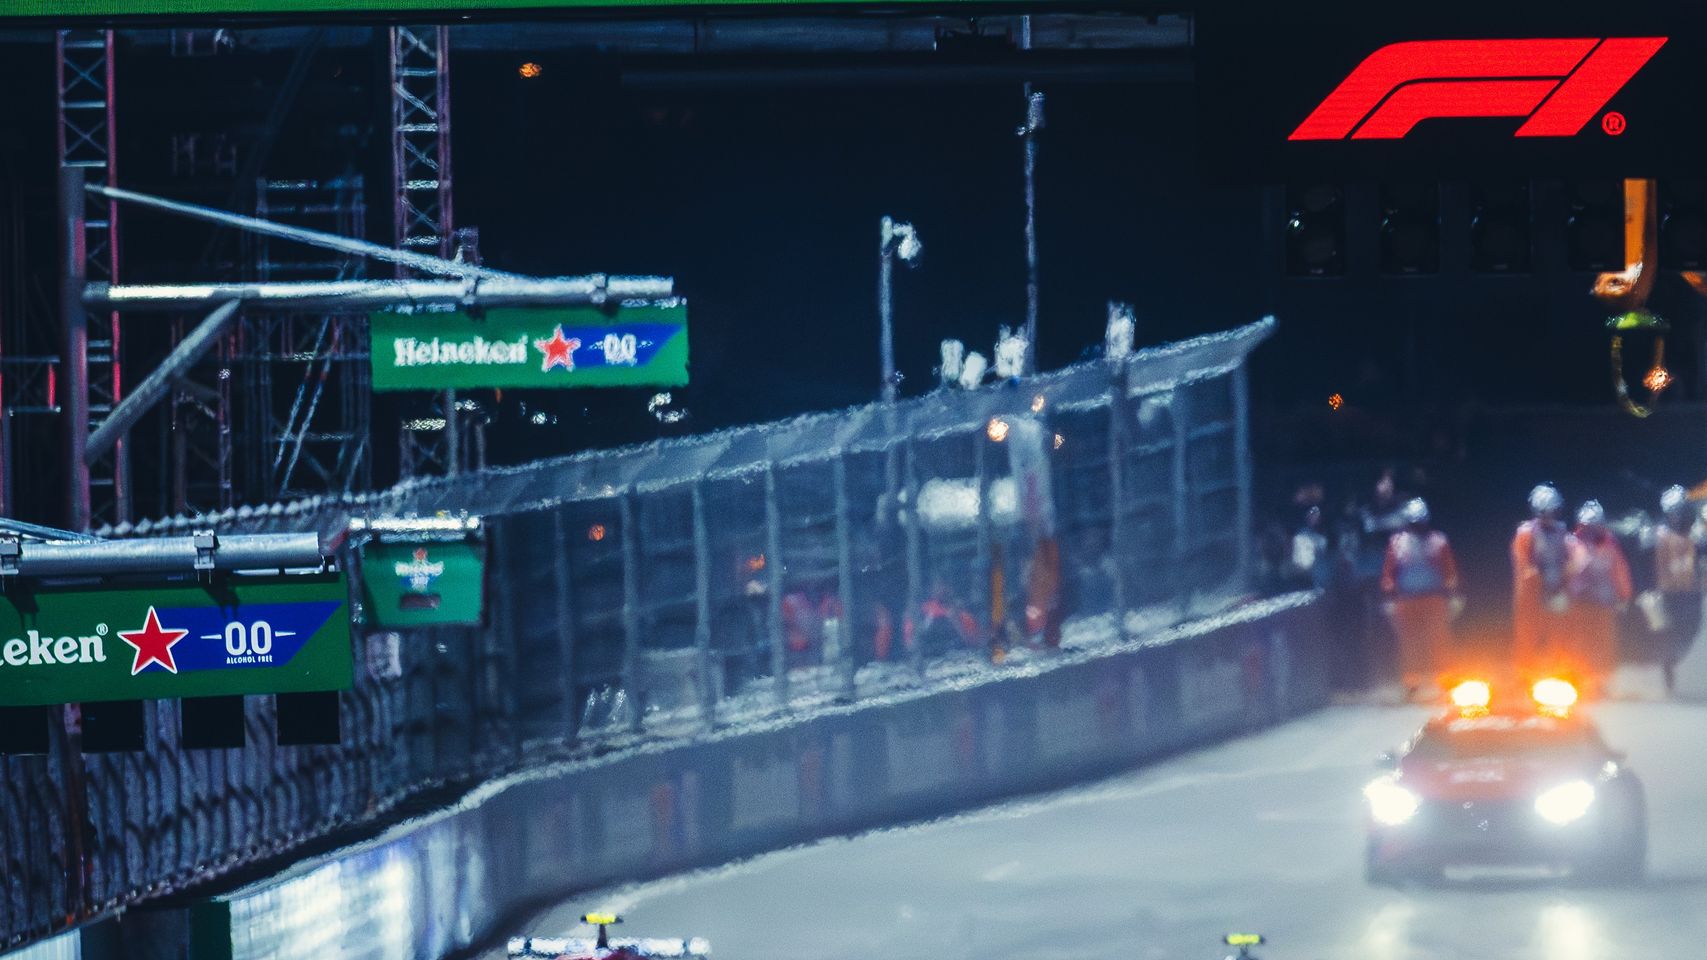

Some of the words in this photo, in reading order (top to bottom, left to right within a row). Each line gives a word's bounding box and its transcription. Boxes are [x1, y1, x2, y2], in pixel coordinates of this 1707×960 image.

[1288, 37, 1669, 140] F1
[394, 335, 528, 366] Heineken
[0, 630, 107, 666] eken
[225, 620, 272, 655] 0.0
[226, 656, 256, 664] ALCOHOL
[257, 655, 273, 663] FREE
